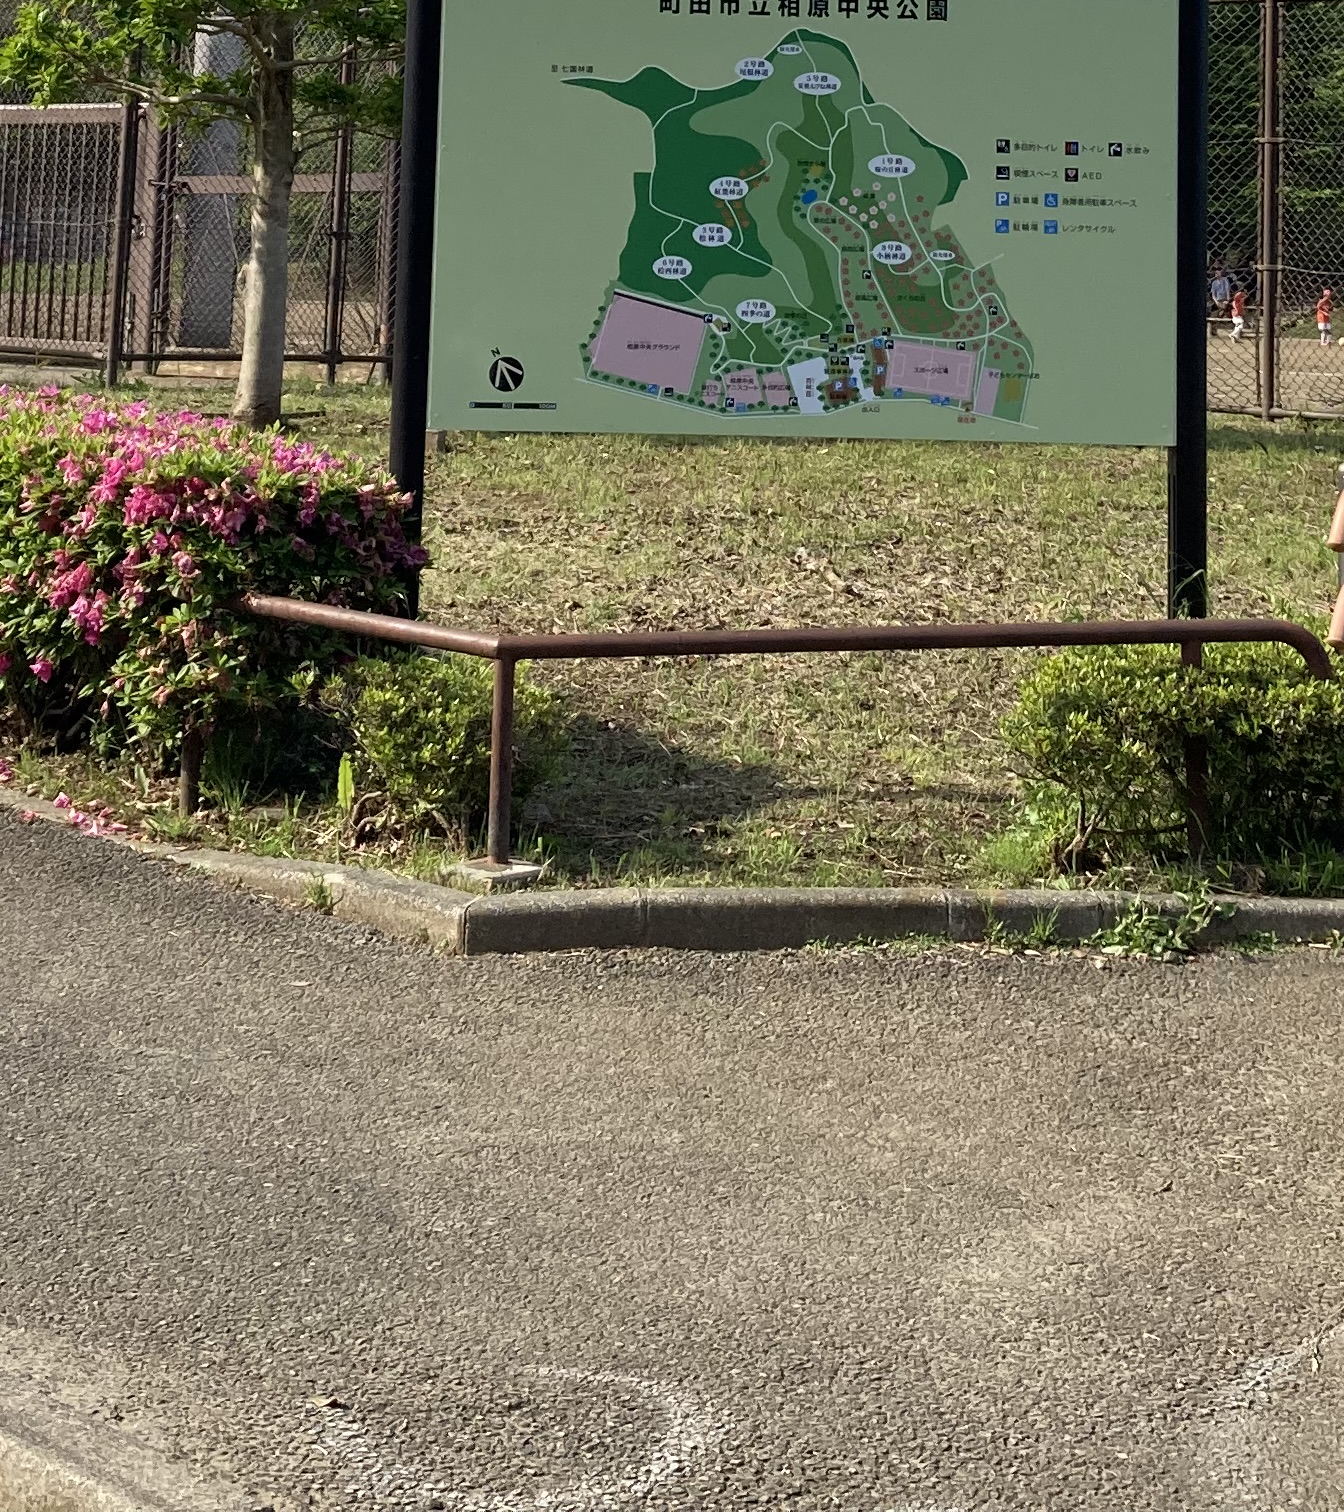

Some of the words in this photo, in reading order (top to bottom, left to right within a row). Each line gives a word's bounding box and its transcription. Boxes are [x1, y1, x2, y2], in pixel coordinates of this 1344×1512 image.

[1014, 142, 1058, 152] 多目的トイレ
[1081, 145, 1104, 153] トイレ
[1081, 172, 1102, 180] AED
[1062, 225, 1116, 234] レンタサイクル
[490, 346, 501, 358] N
